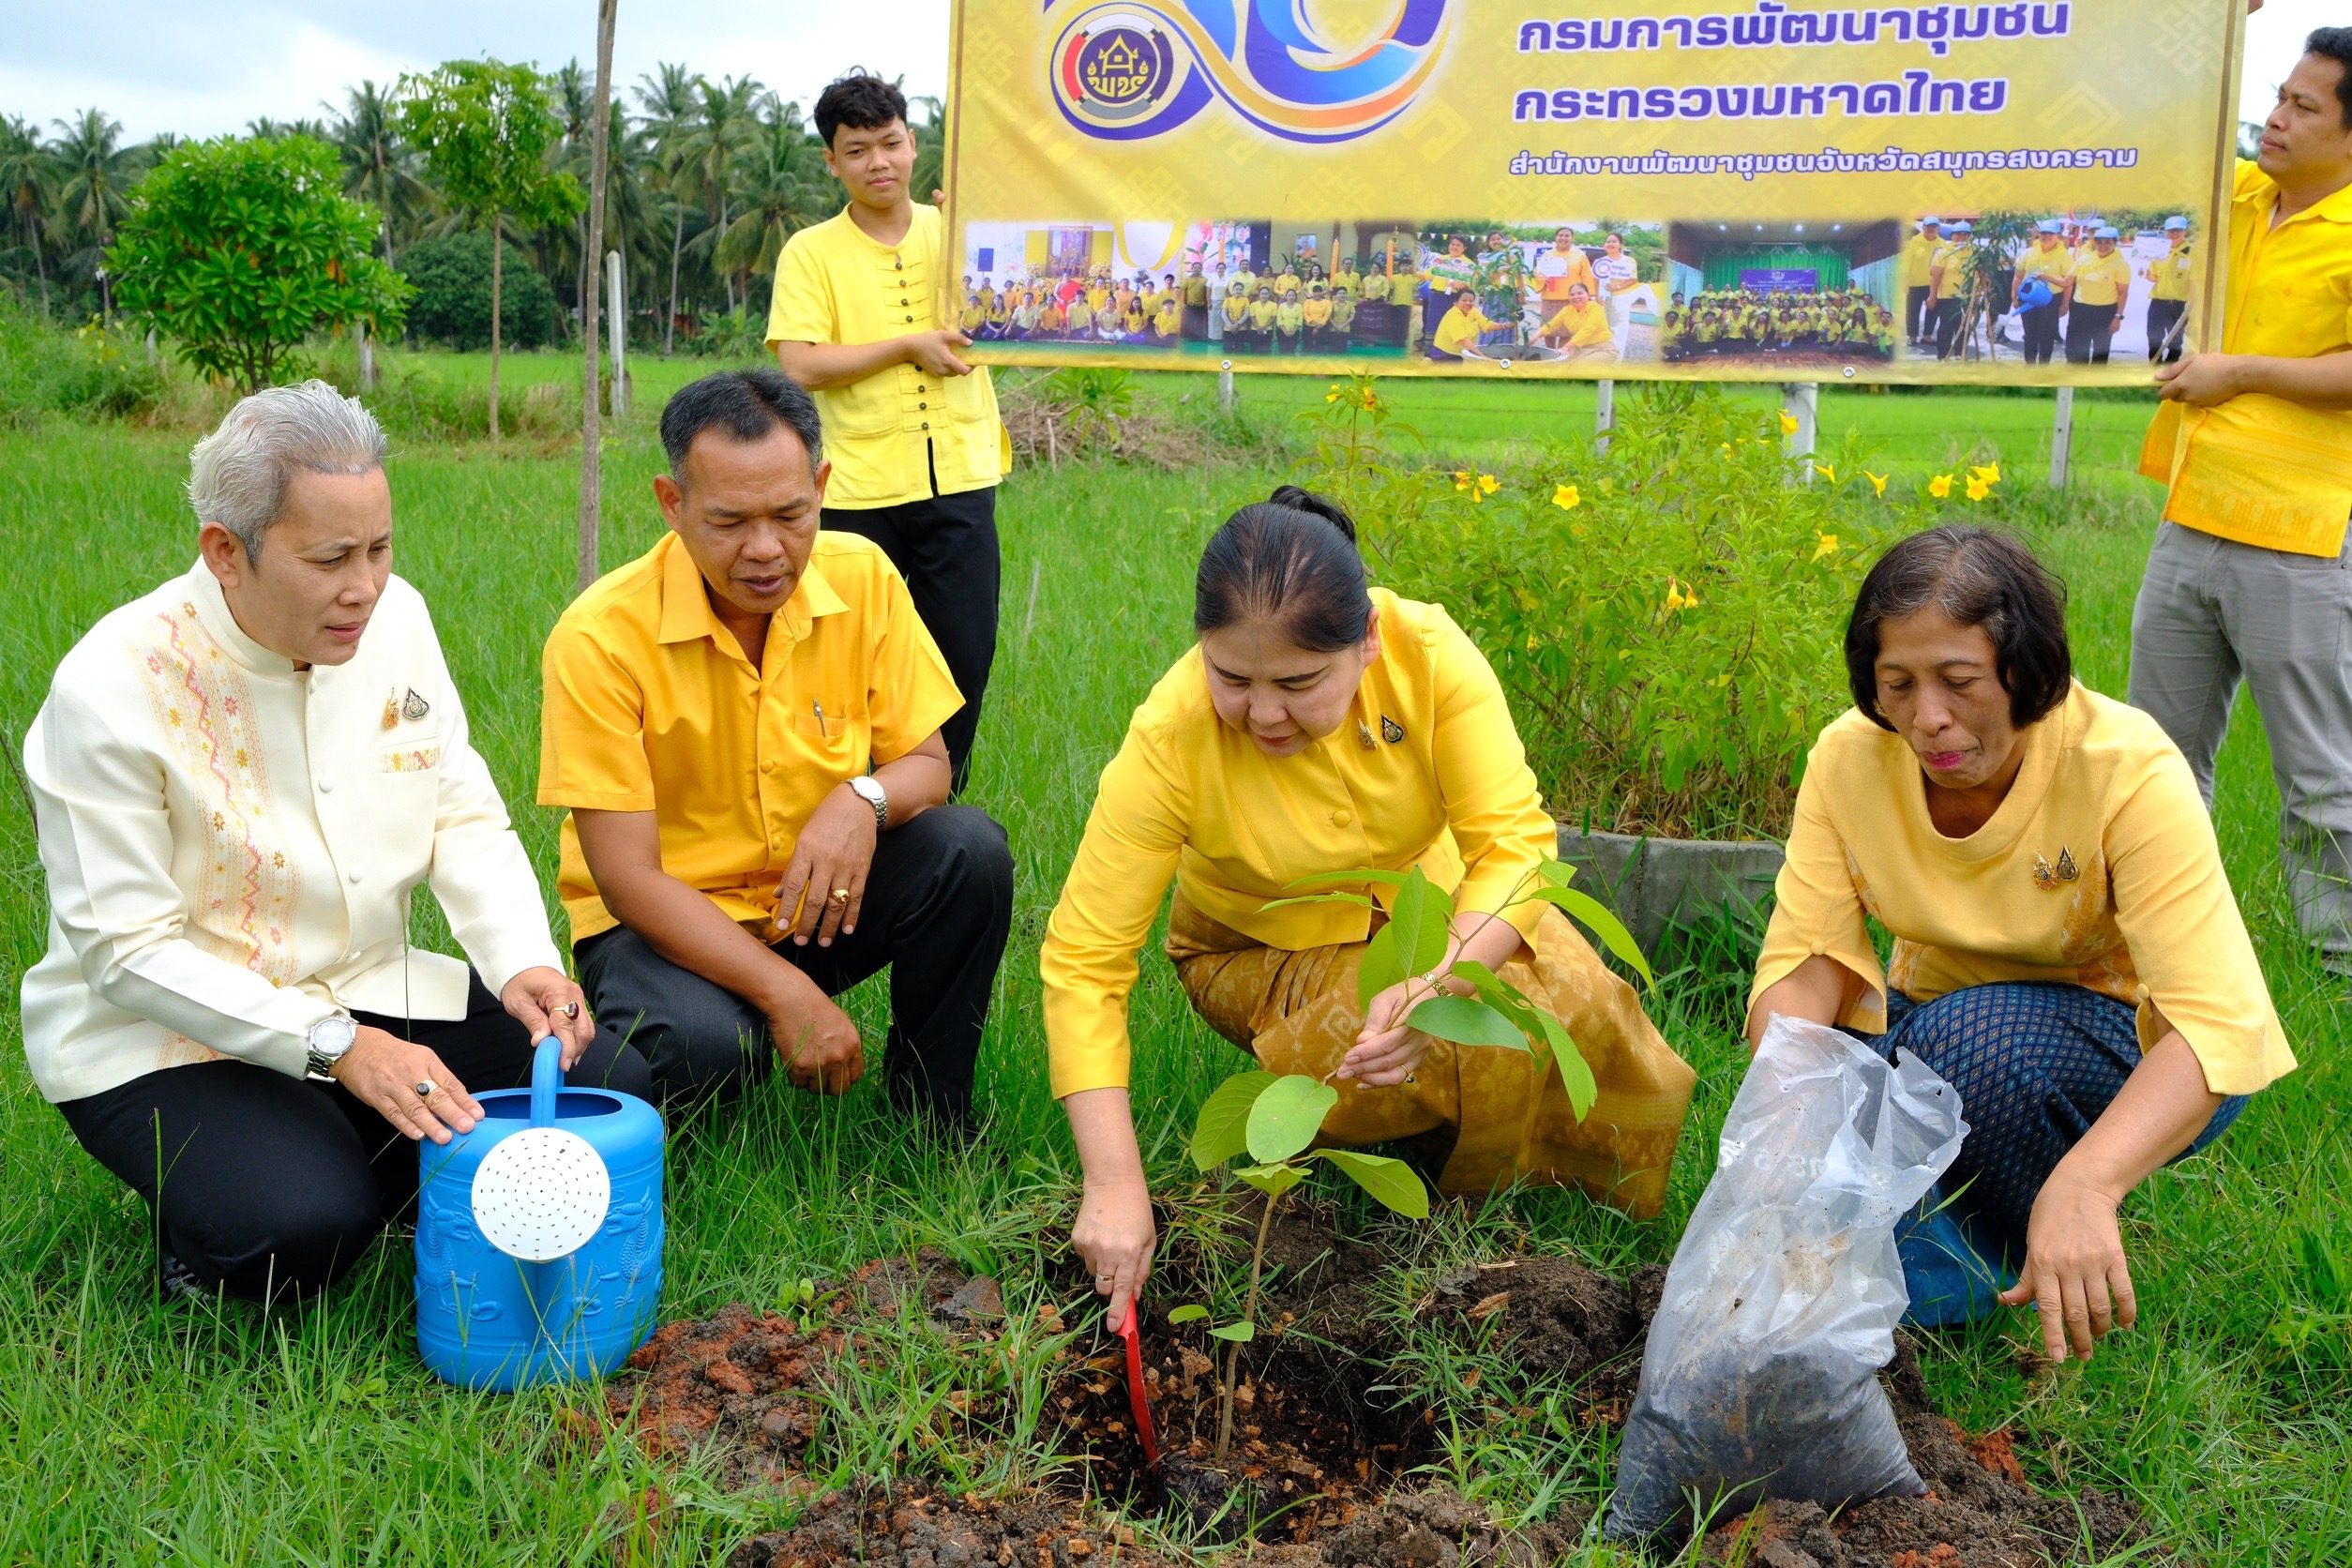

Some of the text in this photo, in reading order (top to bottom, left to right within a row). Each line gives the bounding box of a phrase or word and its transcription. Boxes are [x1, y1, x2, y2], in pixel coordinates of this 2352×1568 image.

[1517, 1, 2071, 56] กรมการพัฒนาชุมชน
[1514, 70, 2008, 121] กระทรวงมหาดไทย
[1509, 145, 2138, 181] สำนักงานพัฒนาชุมชนจังหวัดสมุทรสงคราม
